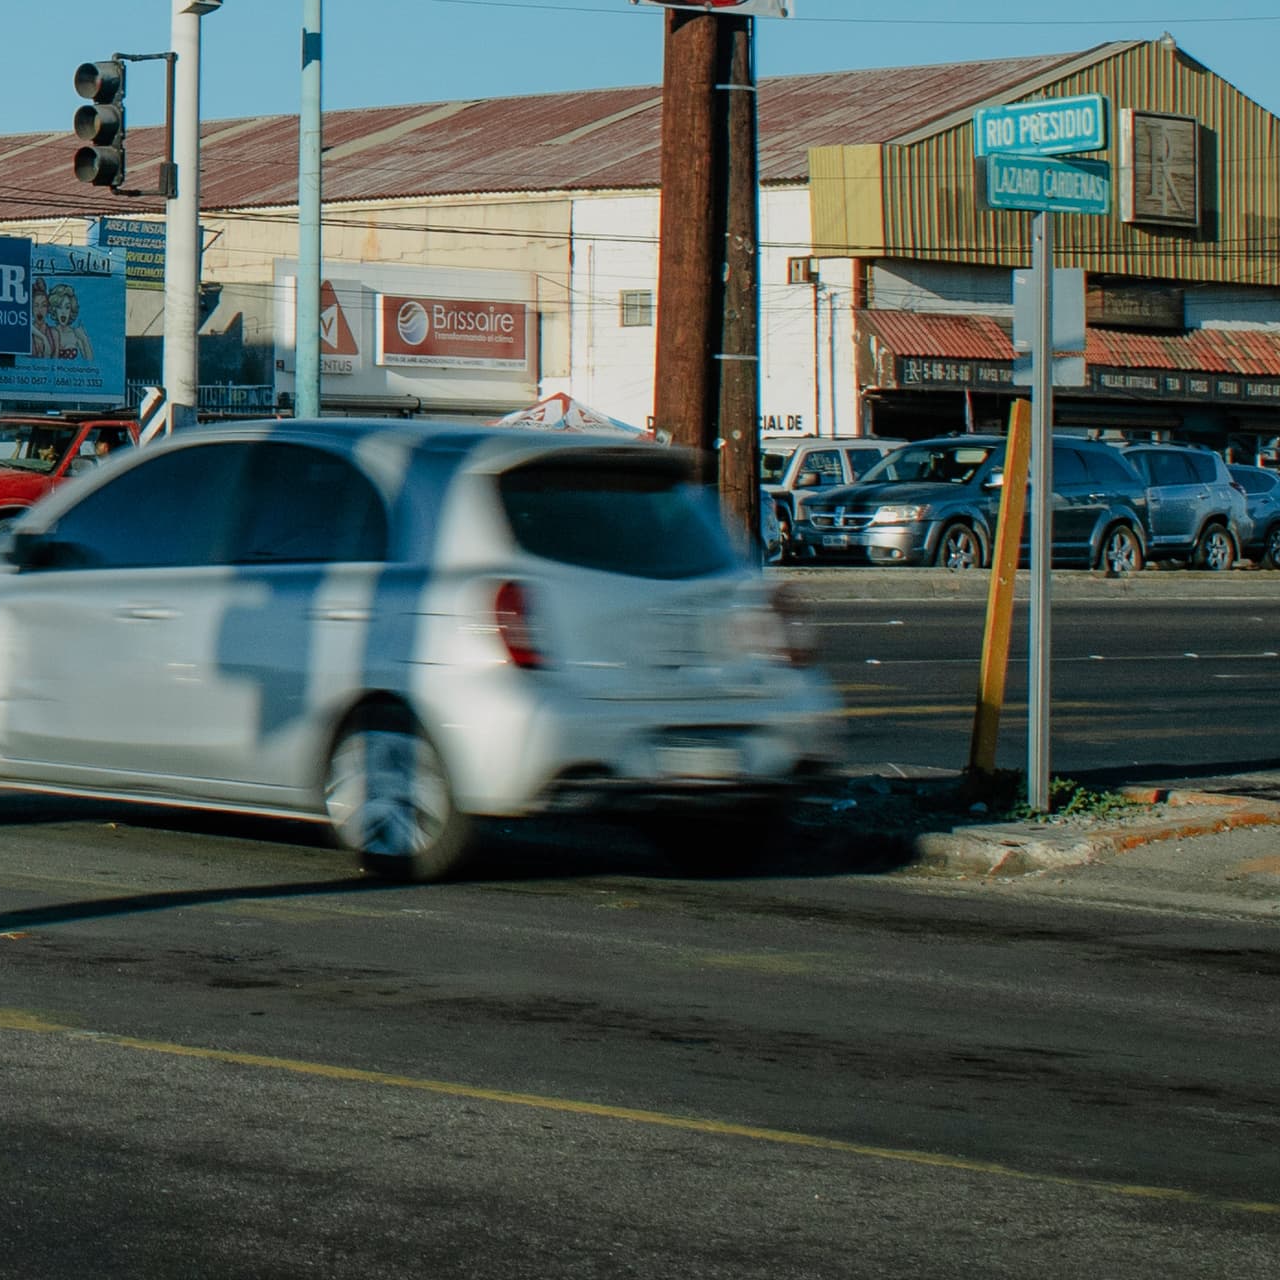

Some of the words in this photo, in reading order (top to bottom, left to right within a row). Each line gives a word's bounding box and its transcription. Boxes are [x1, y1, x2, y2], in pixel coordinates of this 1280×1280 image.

[987, 117, 1014, 147] RIO
[1019, 107, 1094, 144] PRESIDIO
[995, 166, 1039, 196] LAZARO
[1043, 168, 1104, 202] CARDENAS
[128, 221, 140, 233] DE
[69, 251, 111, 272] Salon
[432, 304, 514, 333] Brissaire
[319, 359, 352, 372] ENTUS
[787, 414, 802, 430] DE
